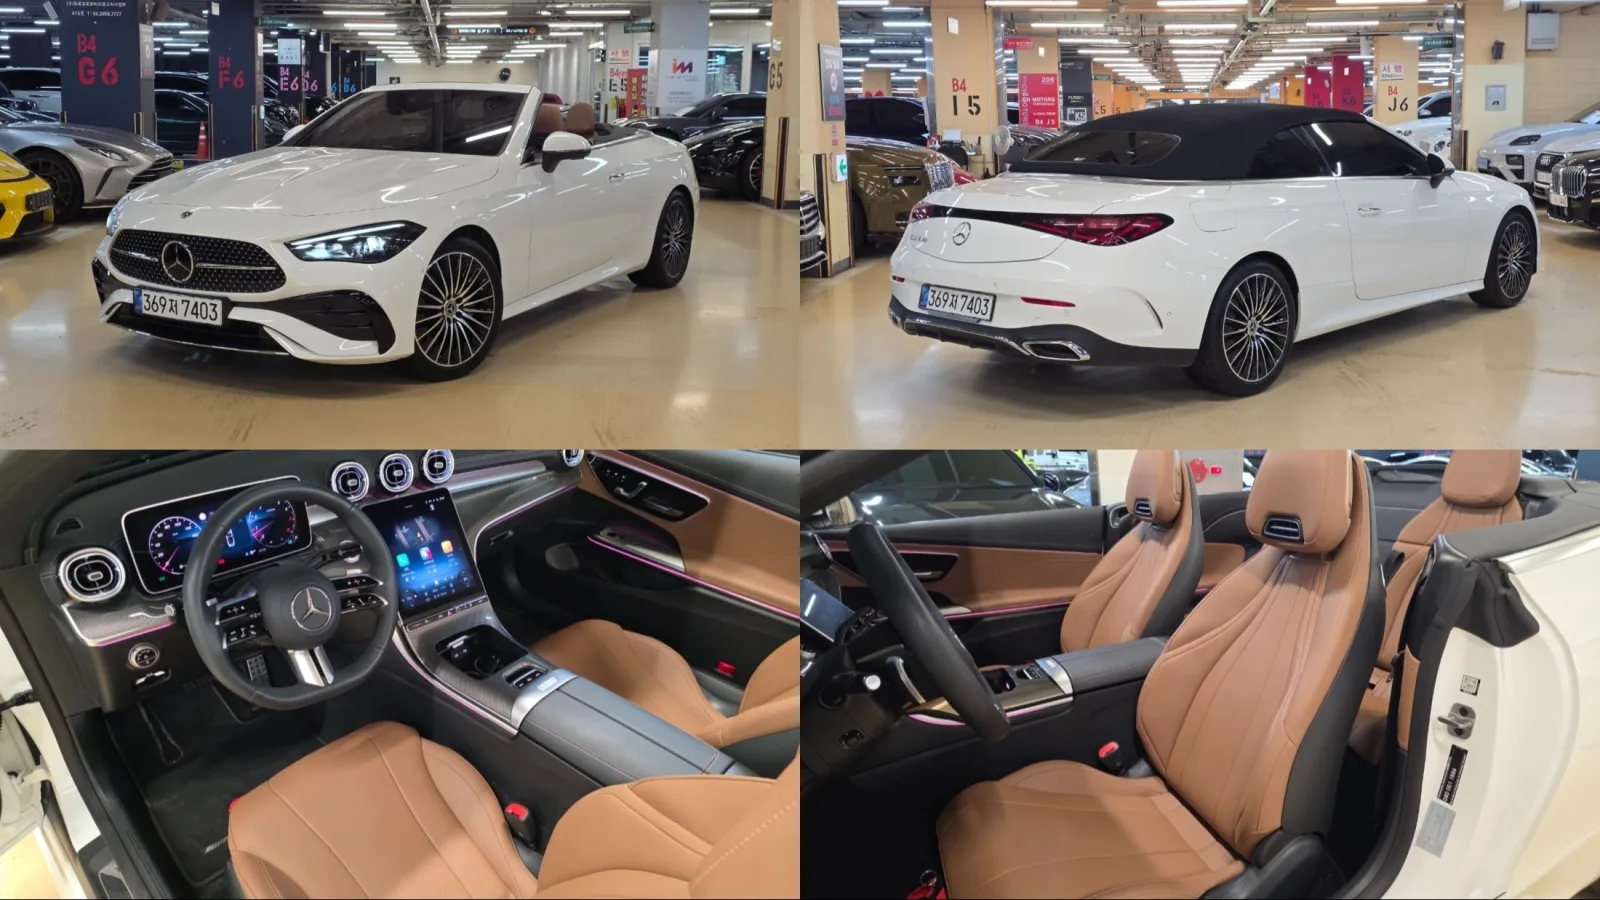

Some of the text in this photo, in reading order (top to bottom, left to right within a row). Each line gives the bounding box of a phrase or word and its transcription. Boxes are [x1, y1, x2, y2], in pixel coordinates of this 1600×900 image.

[77, 33, 96, 53] B4
[219, 56, 231, 68] B4
[78, 57, 119, 86] G6
[280, 67, 289, 76] B4
[219, 70, 245, 89] F6
[280, 76, 299, 91] E6
[952, 78, 967, 92] B4
[1388, 86, 1398, 96] B4
[1388, 97, 1409, 112] J6
[1075, 112, 1086, 121] K5
[143, 293, 218, 322] 369저 7403
[928, 289, 990, 316] 369저 7403
